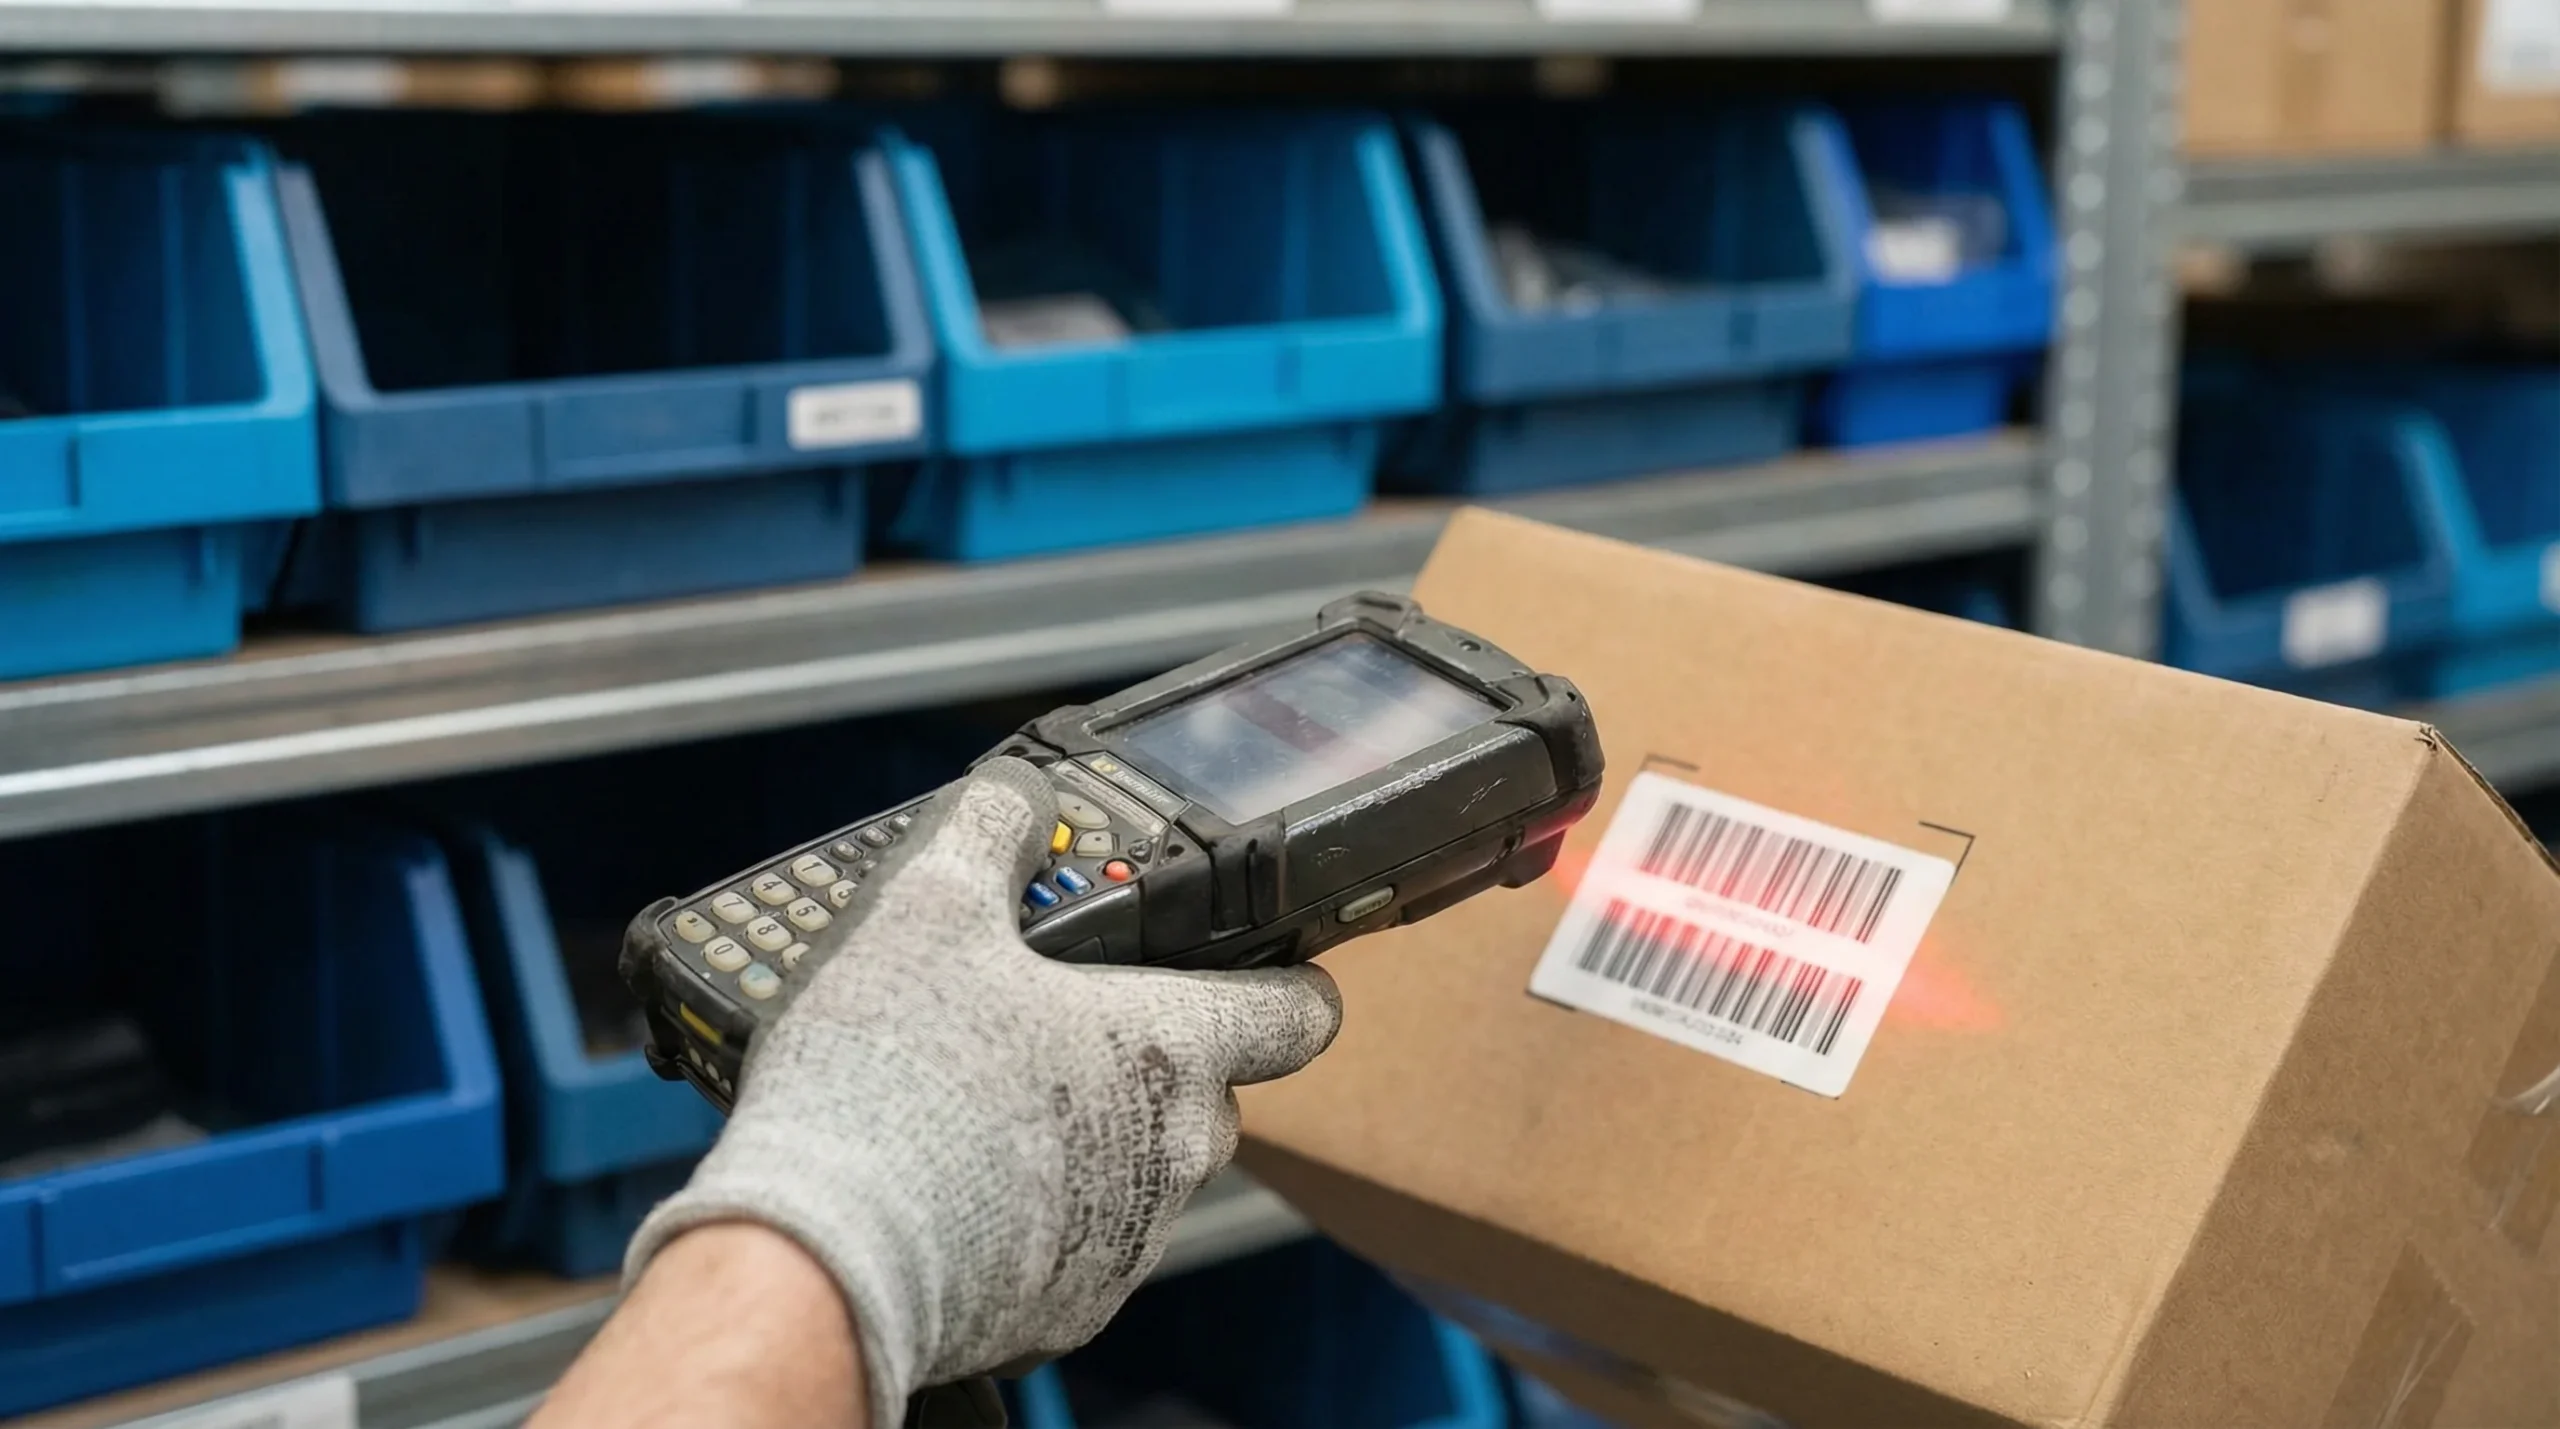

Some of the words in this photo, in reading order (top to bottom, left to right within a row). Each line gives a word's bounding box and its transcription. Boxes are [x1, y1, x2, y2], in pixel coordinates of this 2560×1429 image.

[802, 861, 822, 873] 1
[762, 879, 783, 892] 4
[722, 896, 745, 909] 7
[757, 924, 778, 936] 8
[713, 943, 734, 956] 0
